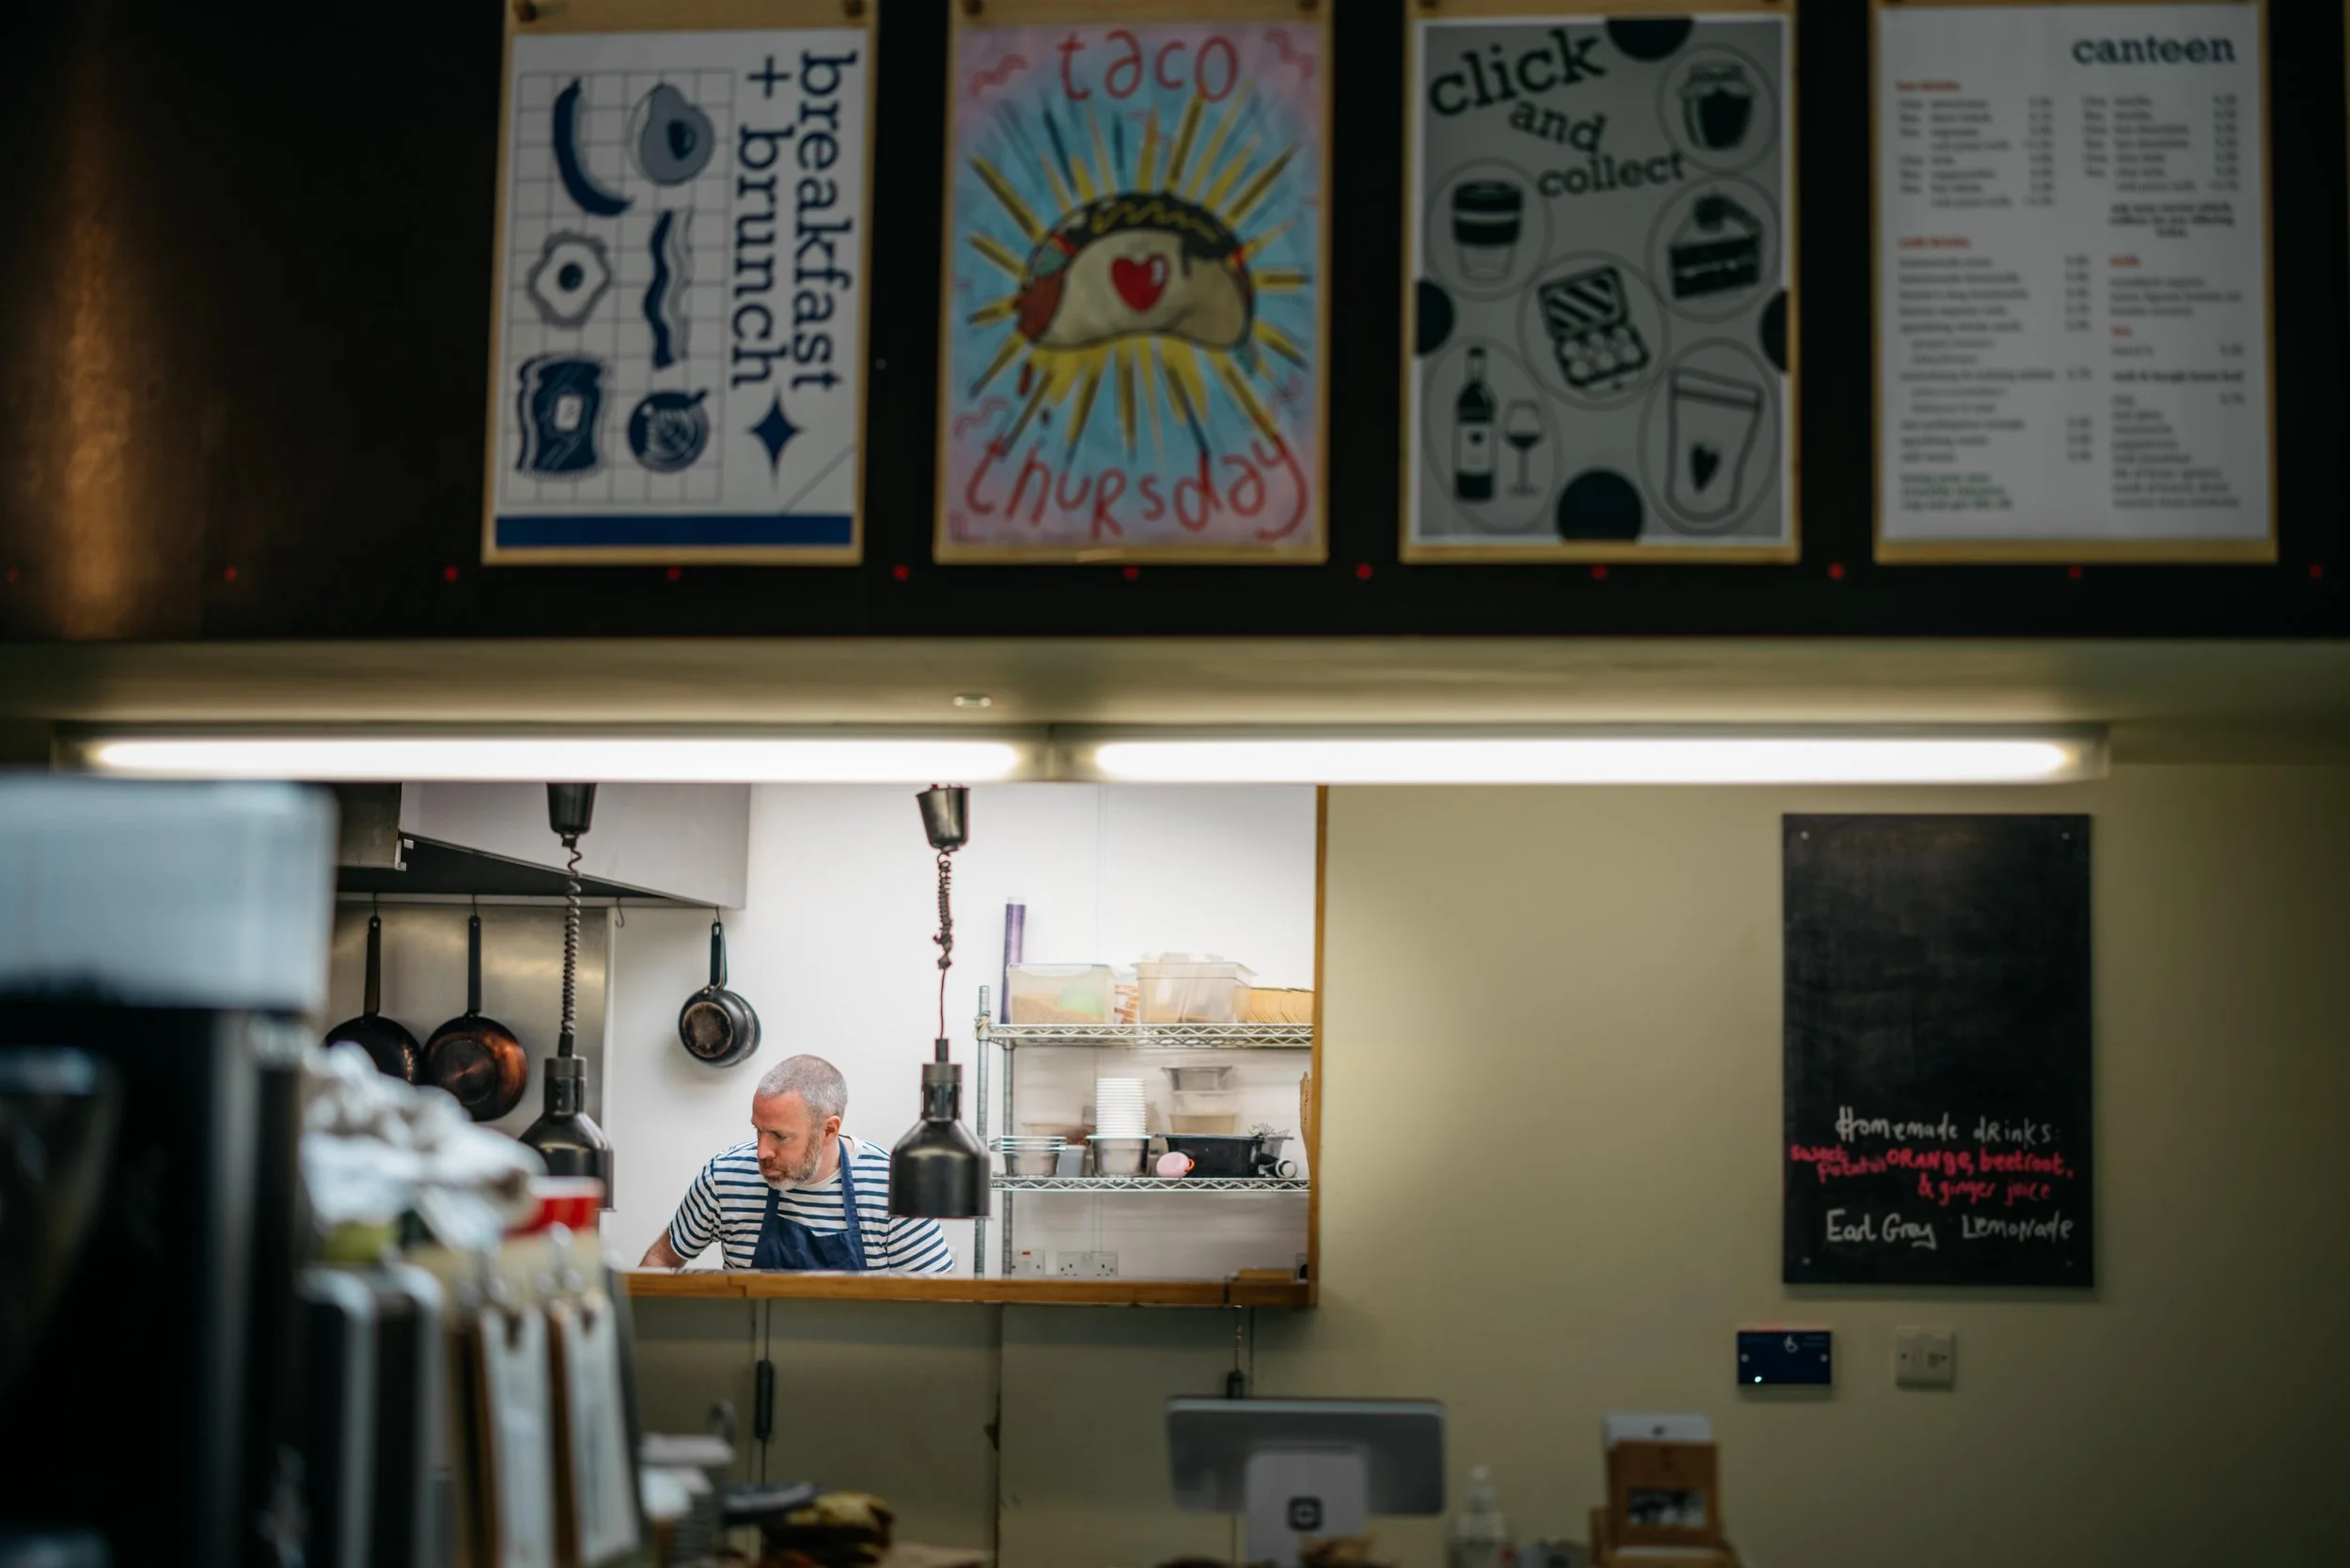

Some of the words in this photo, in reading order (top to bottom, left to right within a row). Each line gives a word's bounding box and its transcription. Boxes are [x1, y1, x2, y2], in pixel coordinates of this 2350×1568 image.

[1058, 29, 1238, 101] taco
[1428, 27, 1606, 117] click
[2072, 37, 2236, 64] canteen
[1510, 101, 1606, 153] and
[1538, 149, 1684, 197] collect
[791, 52, 857, 391] breakfast
[731, 124, 793, 387] brunch
[1836, 1105, 1958, 1143] Homemade
[1918, 1172, 1935, 1199] &
[1938, 1181, 1996, 1207] ginger
[2005, 1181, 2051, 1207] juice
[1826, 1208, 1877, 1242] Earl
[1962, 1211, 2074, 1247] Lemonade
